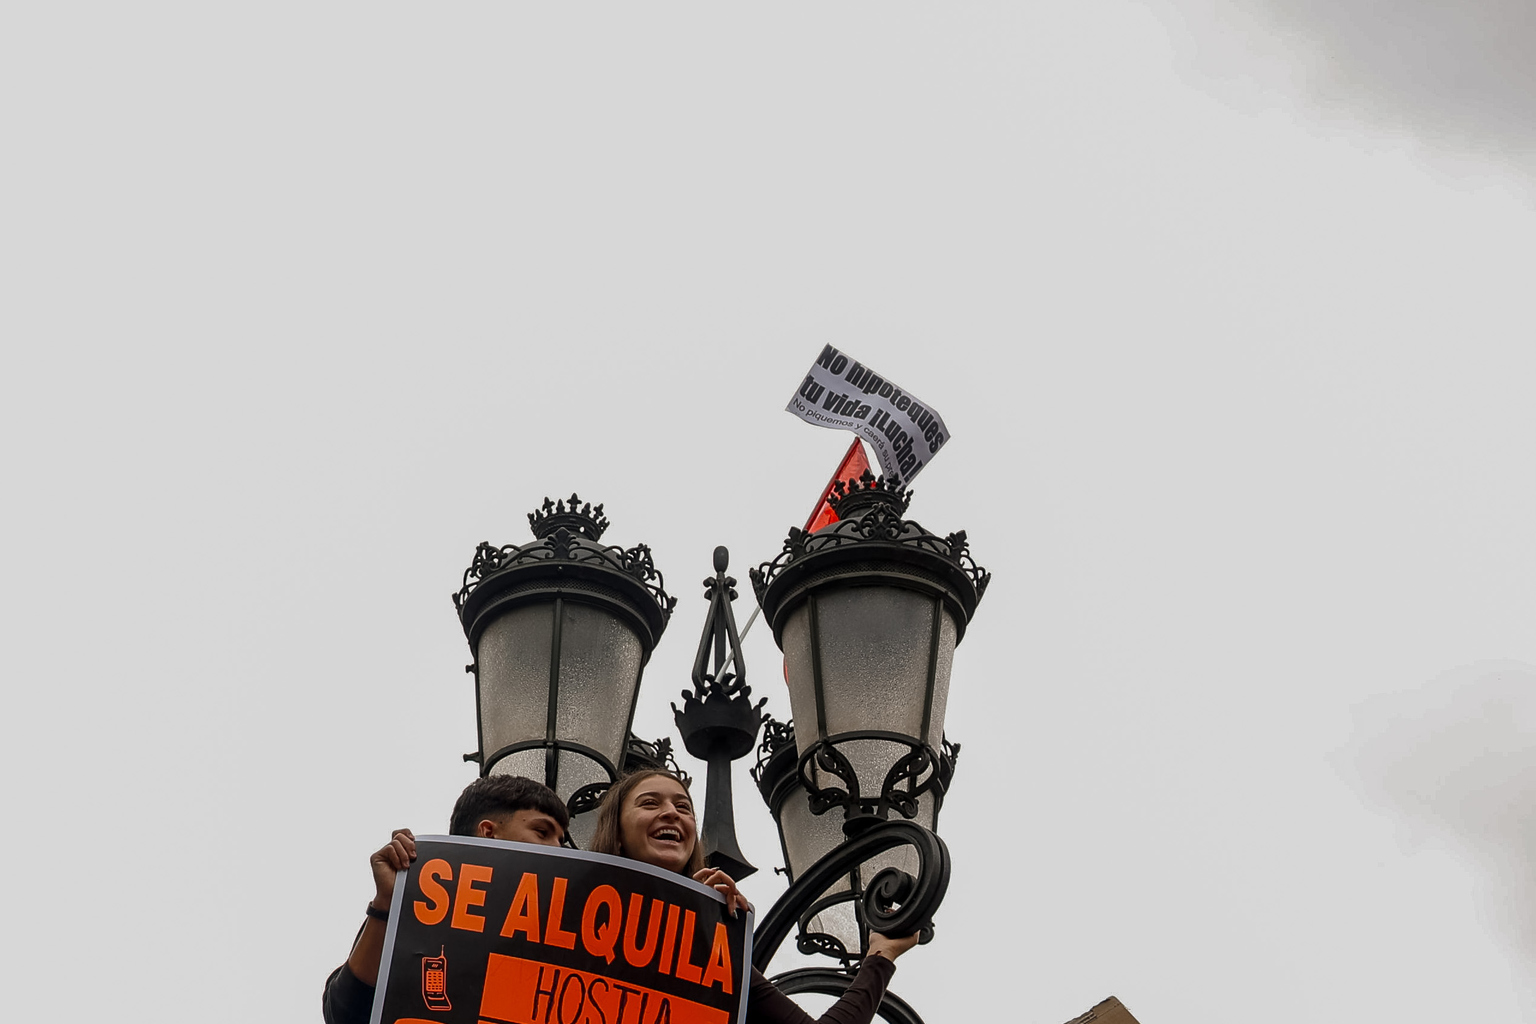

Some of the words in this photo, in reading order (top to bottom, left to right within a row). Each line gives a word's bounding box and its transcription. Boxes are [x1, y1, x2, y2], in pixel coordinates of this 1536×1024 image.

[792, 398, 805, 413] No
[805, 408, 854, 427] piquemos
[799, 374, 825, 404] tu
[822, 390, 872, 422] vida
[816, 346, 848, 376] No
[845, 361, 944, 454] hipoteques
[413, 858, 494, 934] SE
[500, 872, 733, 995] ALQUILA
